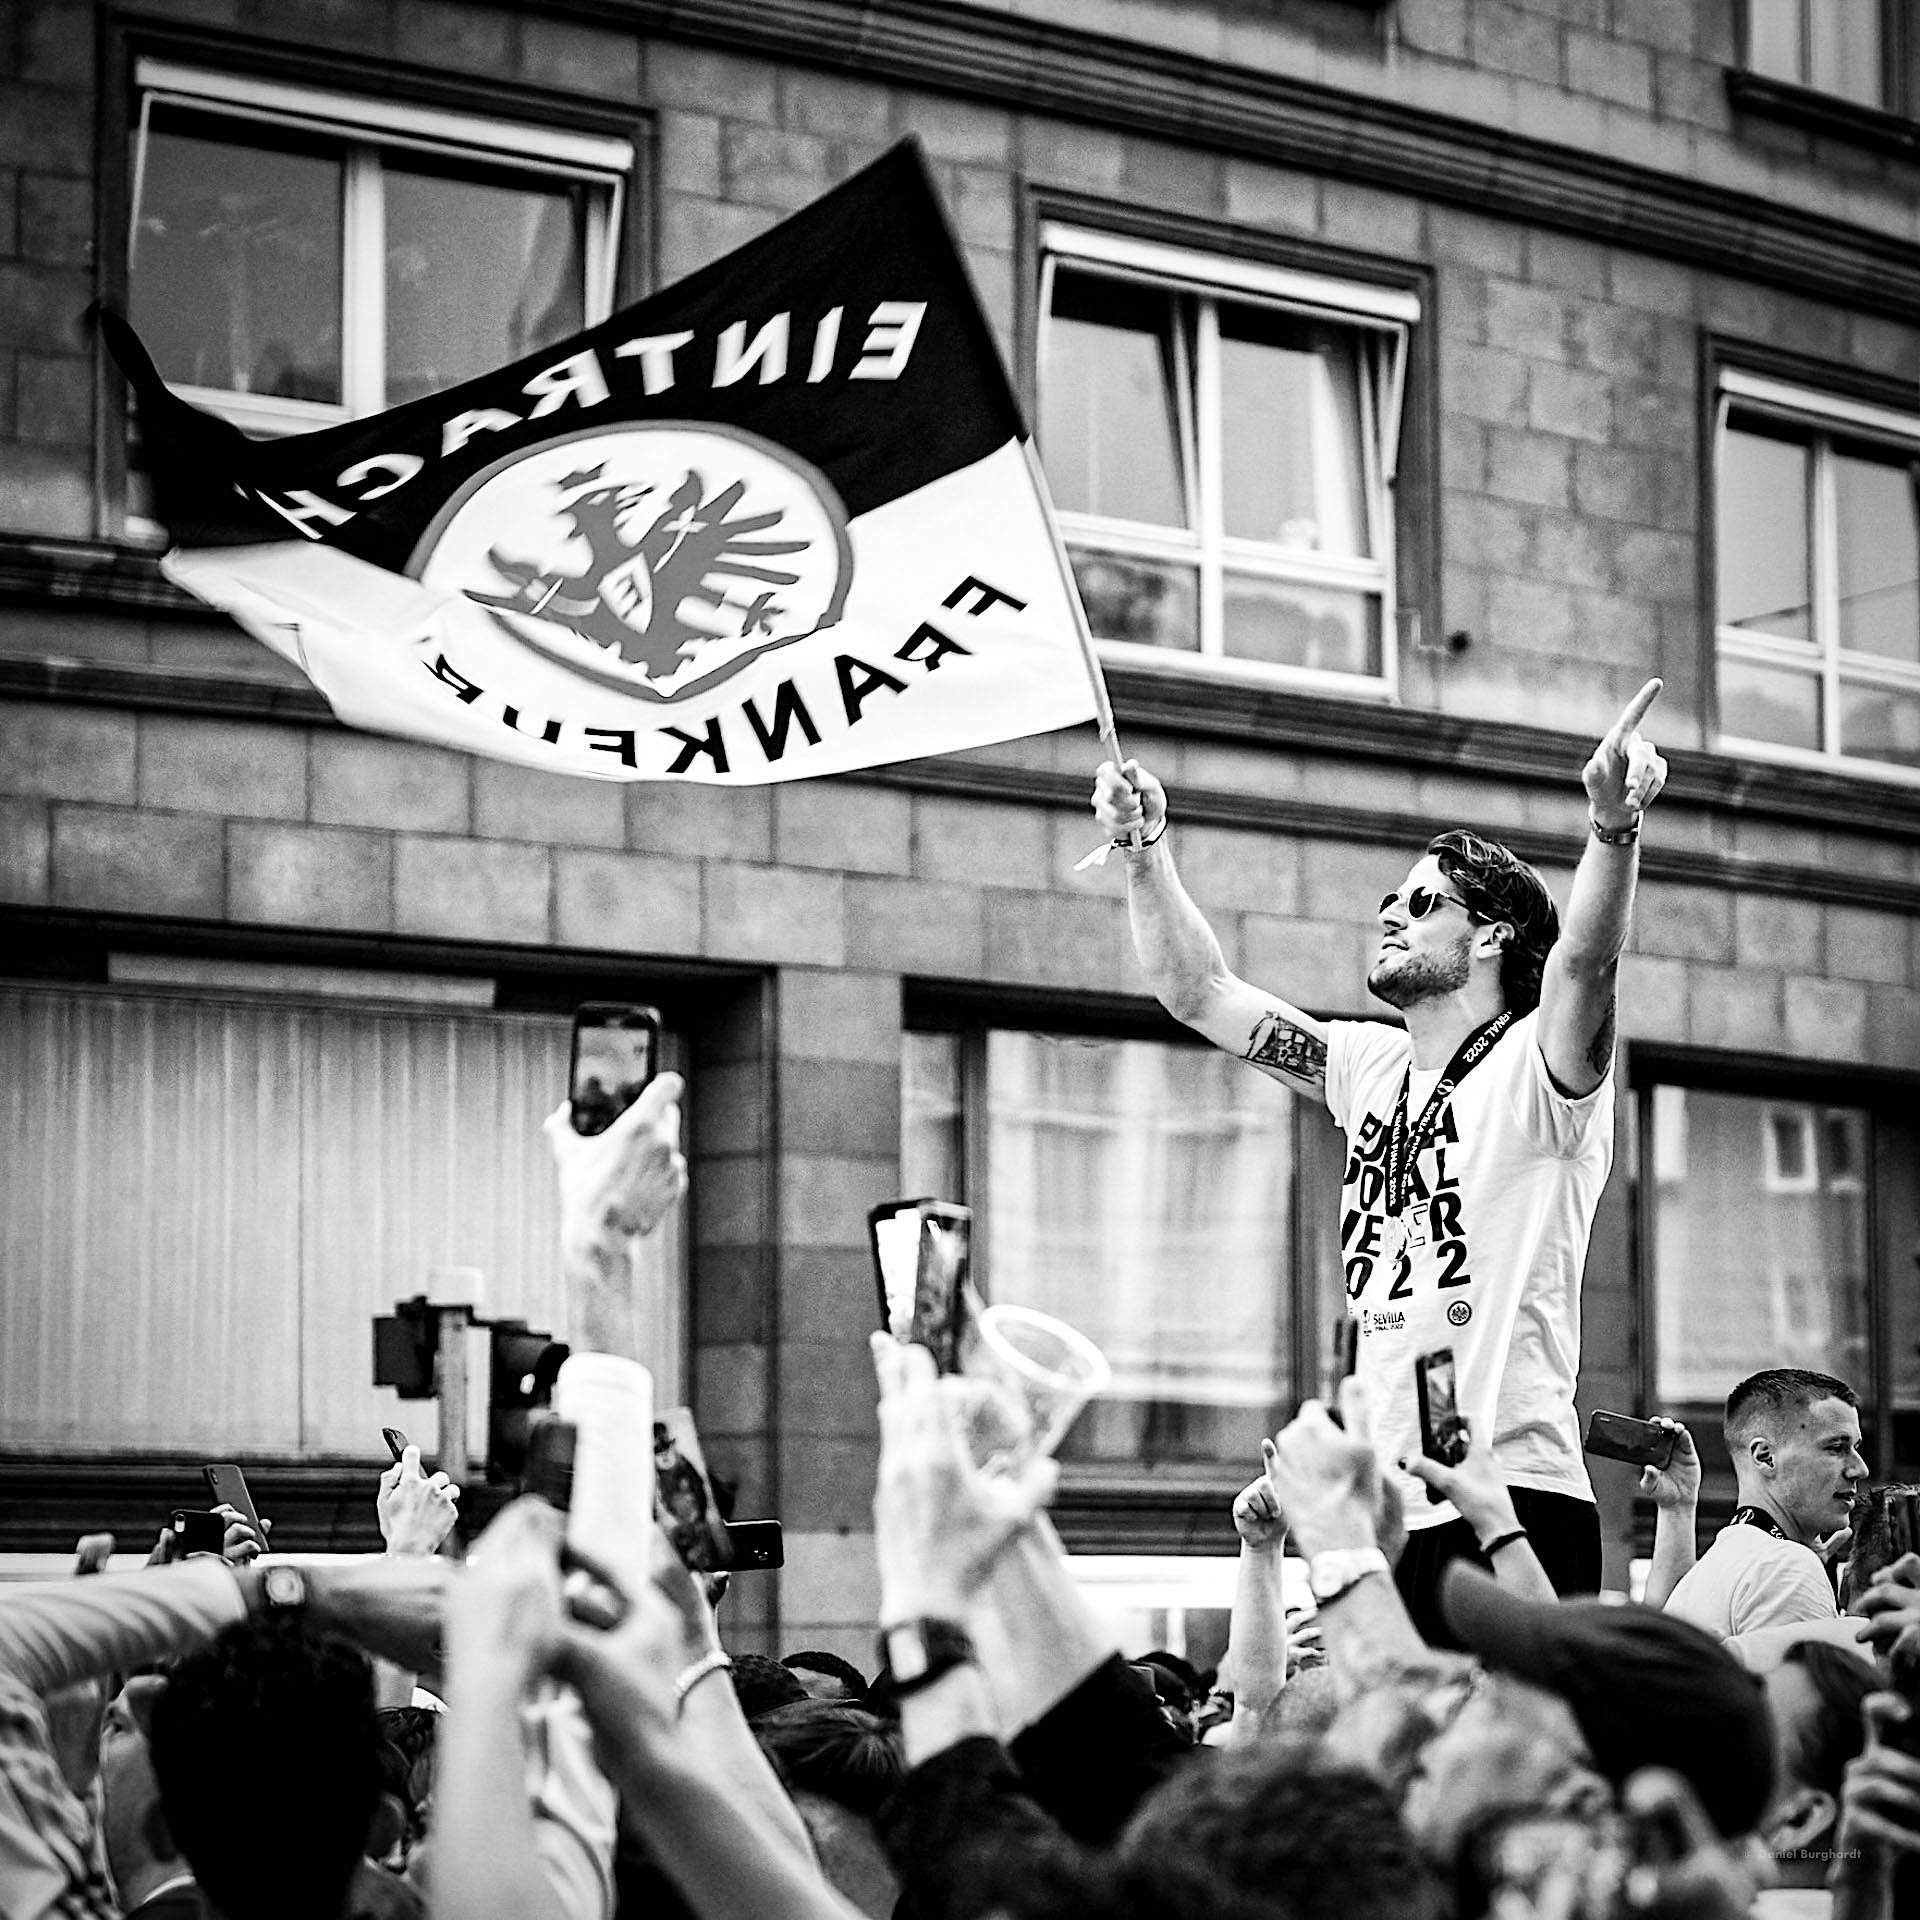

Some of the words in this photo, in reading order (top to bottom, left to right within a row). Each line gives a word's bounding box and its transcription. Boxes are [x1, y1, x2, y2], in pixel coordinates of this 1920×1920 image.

[1484, 1013, 1511, 1038] FINAL
[1462, 1036, 1489, 1063] 2022
[1373, 1311, 1405, 1325] SEVILLA
